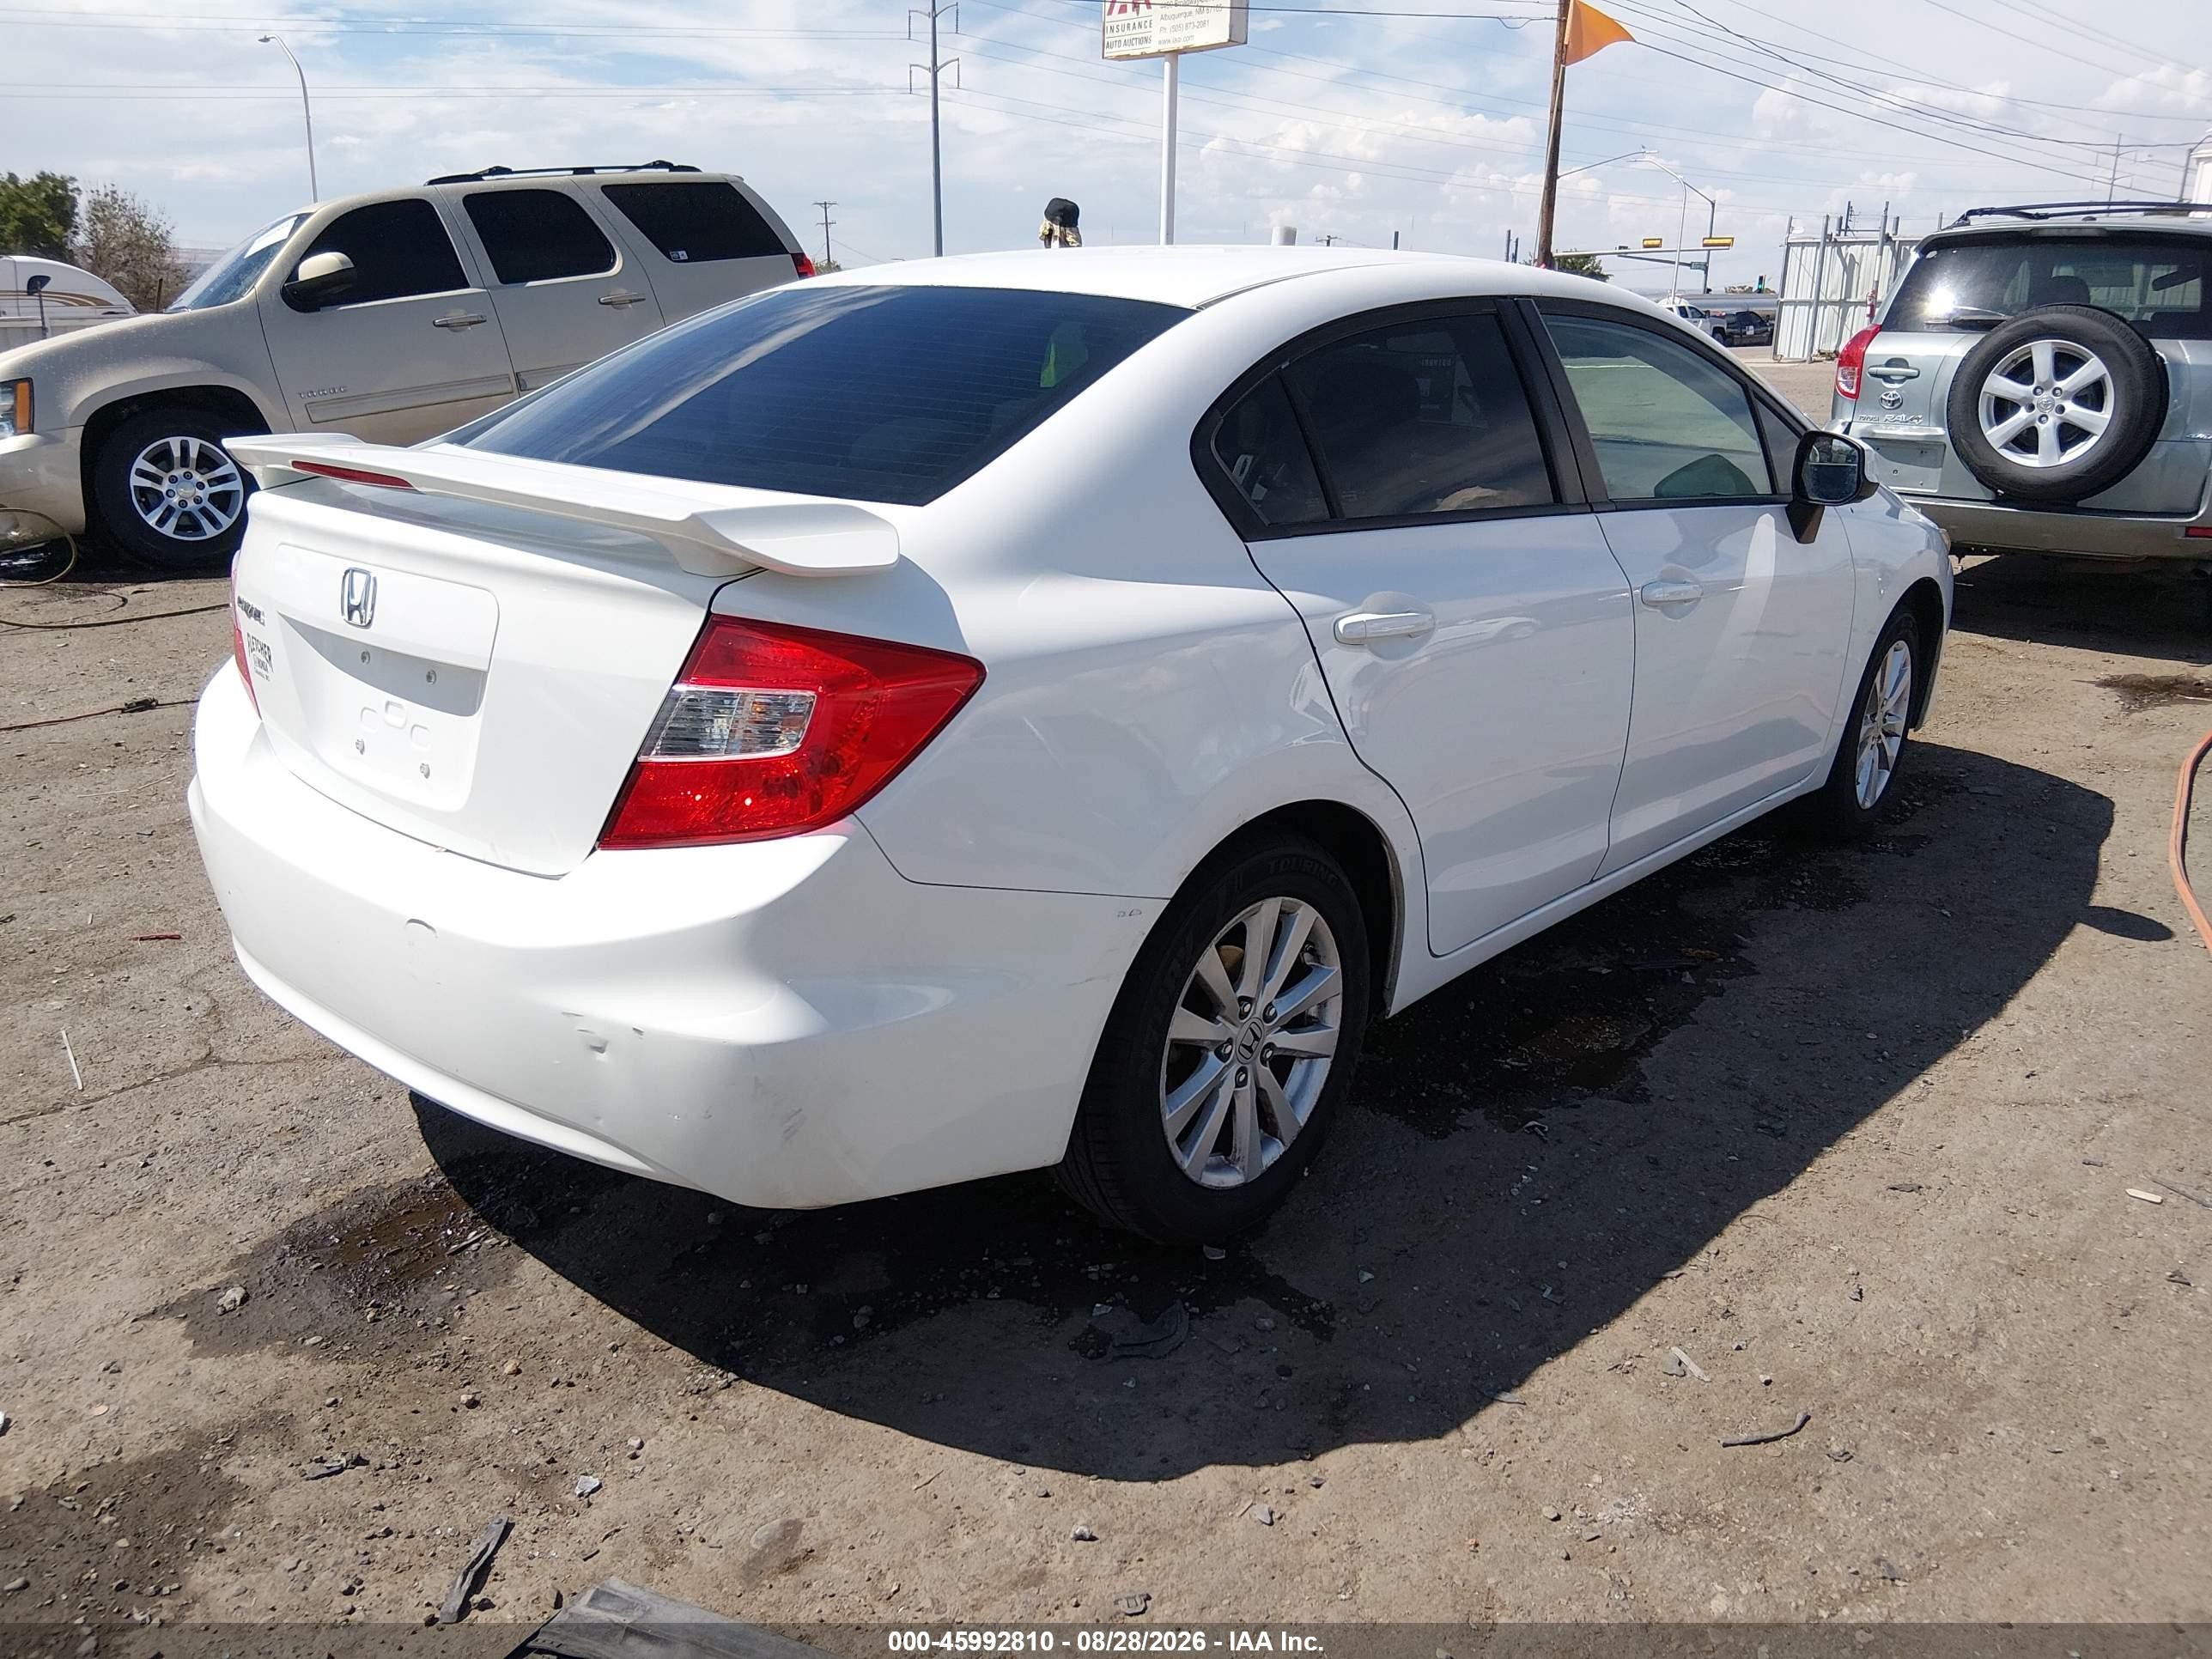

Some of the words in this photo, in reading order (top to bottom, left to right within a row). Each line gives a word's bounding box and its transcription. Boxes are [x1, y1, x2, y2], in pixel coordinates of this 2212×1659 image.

[1106, 19, 1153, 34] INSURANCE
[1170, 22, 1184, 34] (505)
[1106, 40, 1122, 51] AUTO
[1122, 35, 1152, 47] AUCTIONS
[1883, 413, 1923, 425] RAV4
[1269, 856, 1340, 888] TOURING
